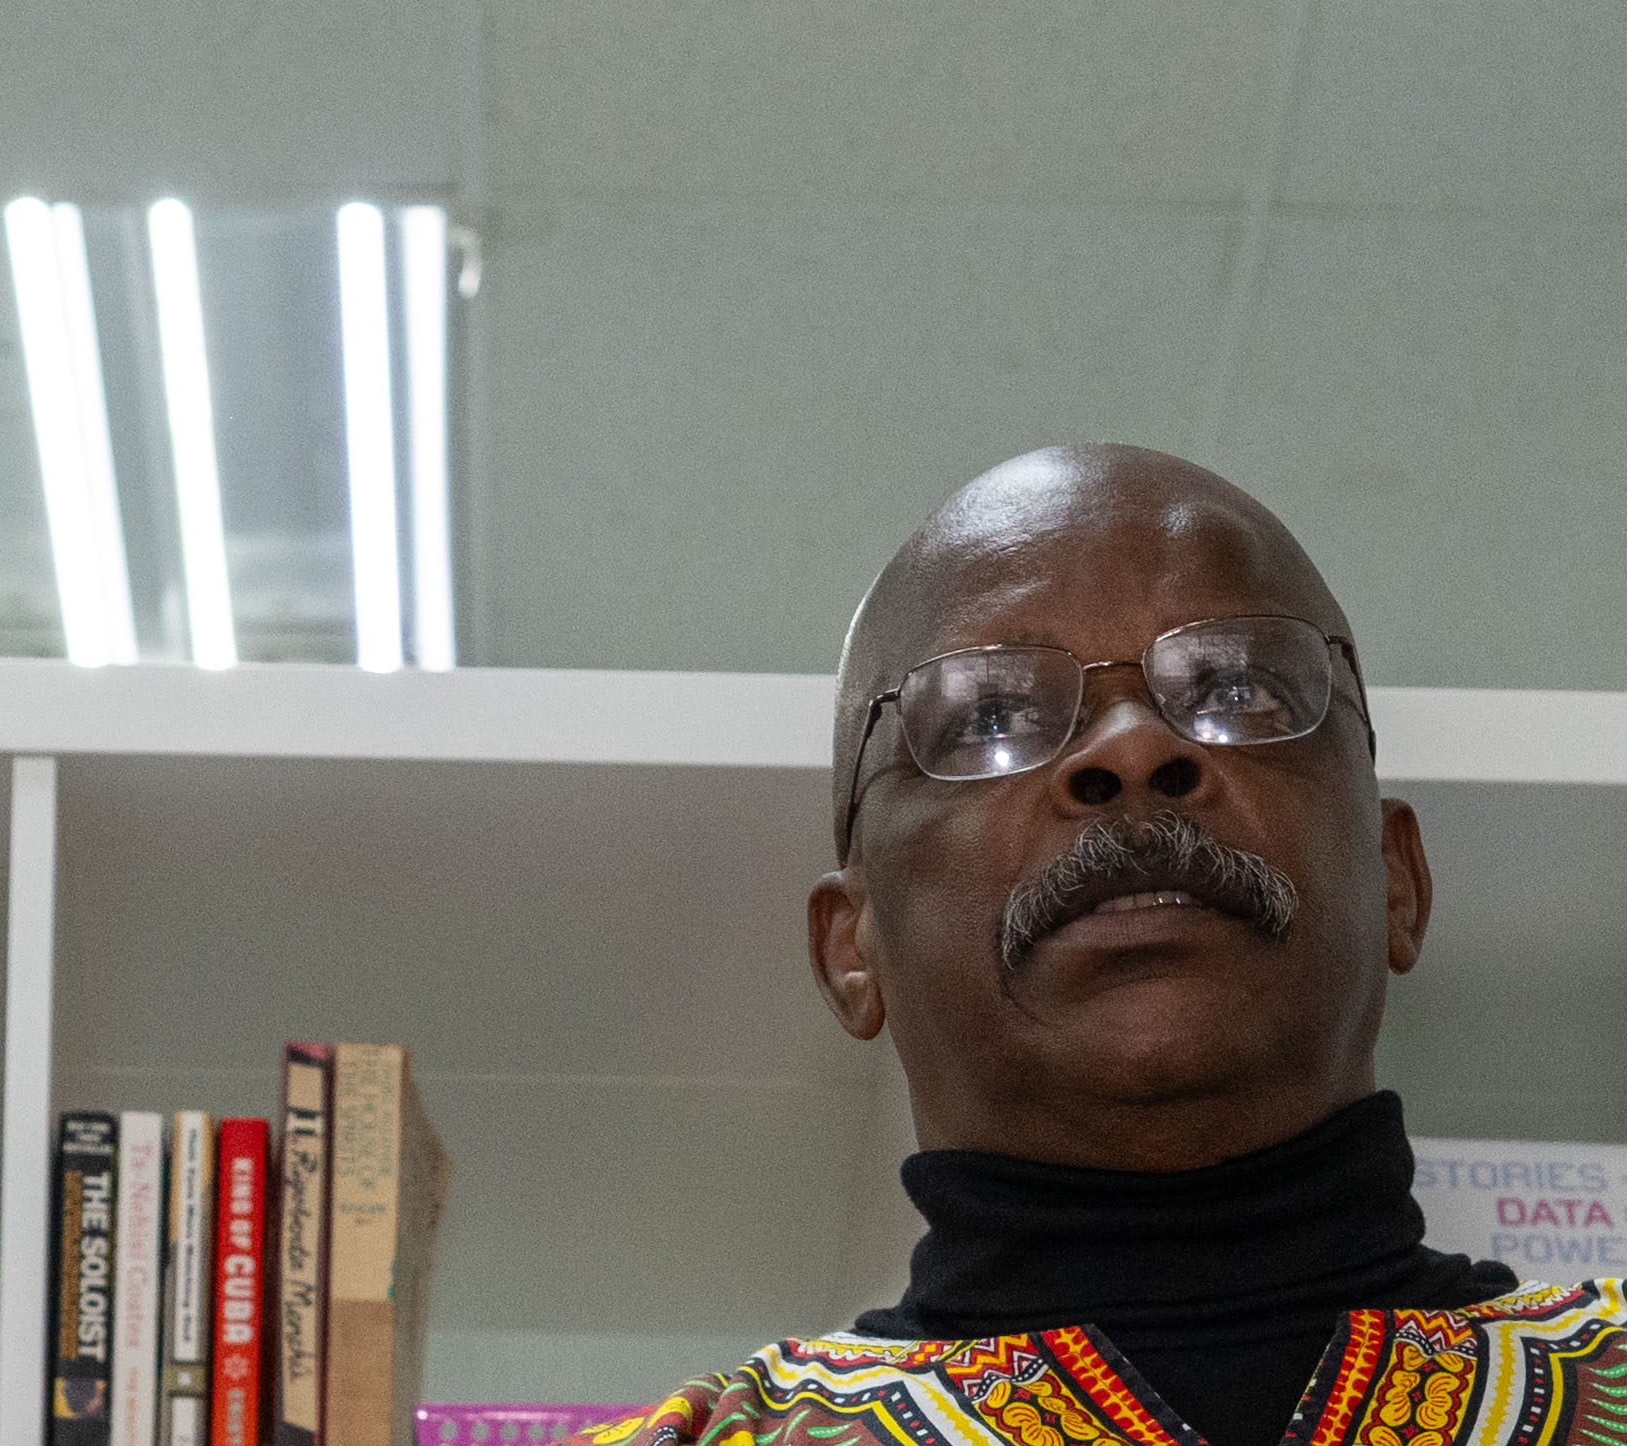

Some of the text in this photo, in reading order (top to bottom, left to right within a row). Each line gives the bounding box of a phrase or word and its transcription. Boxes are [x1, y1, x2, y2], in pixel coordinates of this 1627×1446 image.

[83, 1172, 109, 1230] THE
[184, 1167, 197, 1200] Eyes
[1415, 1158, 1608, 1193] STORIES
[285, 1151, 320, 1270] Rigoberta
[1496, 1198, 1615, 1229] DATA
[125, 1140, 153, 1350] Ta-Nehisi Coates
[181, 1244, 195, 1309] Watching
[222, 1158, 256, 1344] KING OF CUBA
[78, 1236, 107, 1361] SOLOIST
